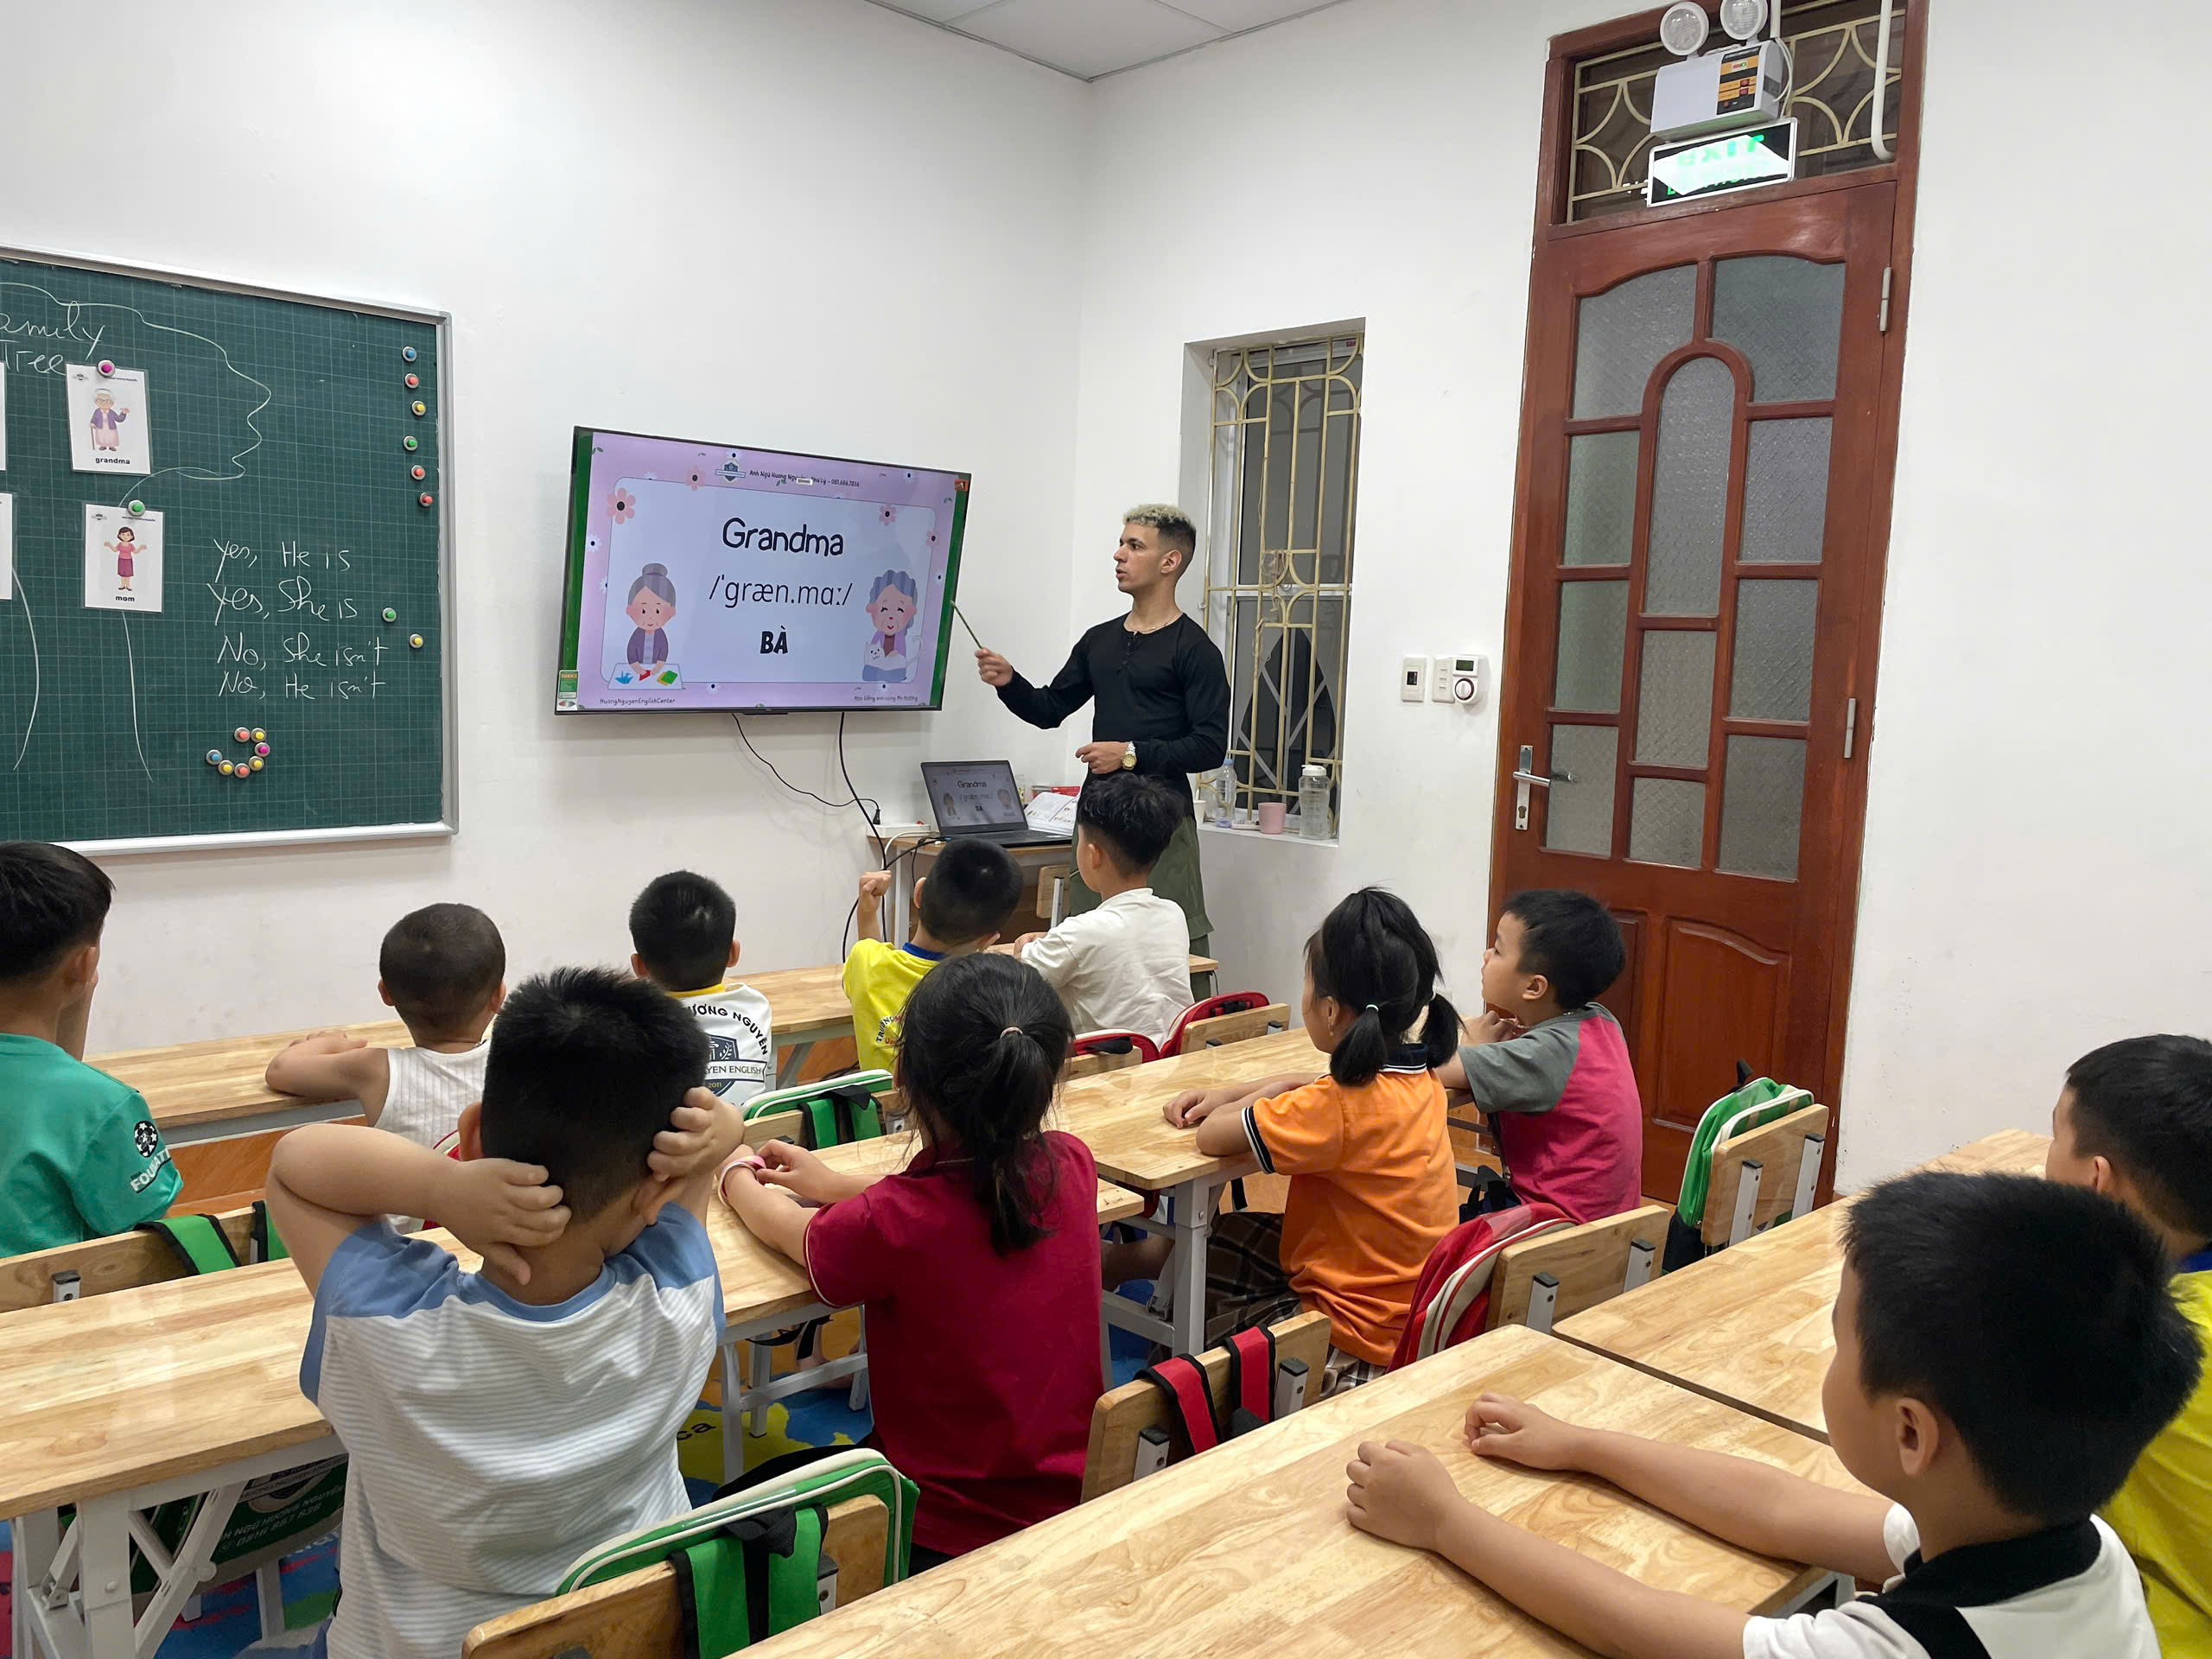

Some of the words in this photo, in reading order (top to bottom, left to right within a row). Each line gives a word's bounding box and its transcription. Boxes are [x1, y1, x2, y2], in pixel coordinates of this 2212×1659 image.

[0, 301, 105, 360] amily
[0, 339, 67, 376] Tree
[722, 517, 844, 557] Grandma
[282, 540, 310, 568] He
[326, 544, 351, 571] is
[277, 575, 330, 621] She
[338, 594, 359, 620] is
[217, 632, 266, 671] No,
[283, 632, 327, 666] She
[335, 636, 390, 667] isn't
[760, 625, 789, 655] BÀ
[219, 671, 266, 699] No,
[285, 671, 315, 699] He
[331, 670, 386, 700] isn't
[957, 780, 988, 789] Grandma
[688, 1003, 728, 1017] ƯƠNG
[706, 1065, 727, 1074] YEN
[729, 1065, 761, 1075] ENGLISH
